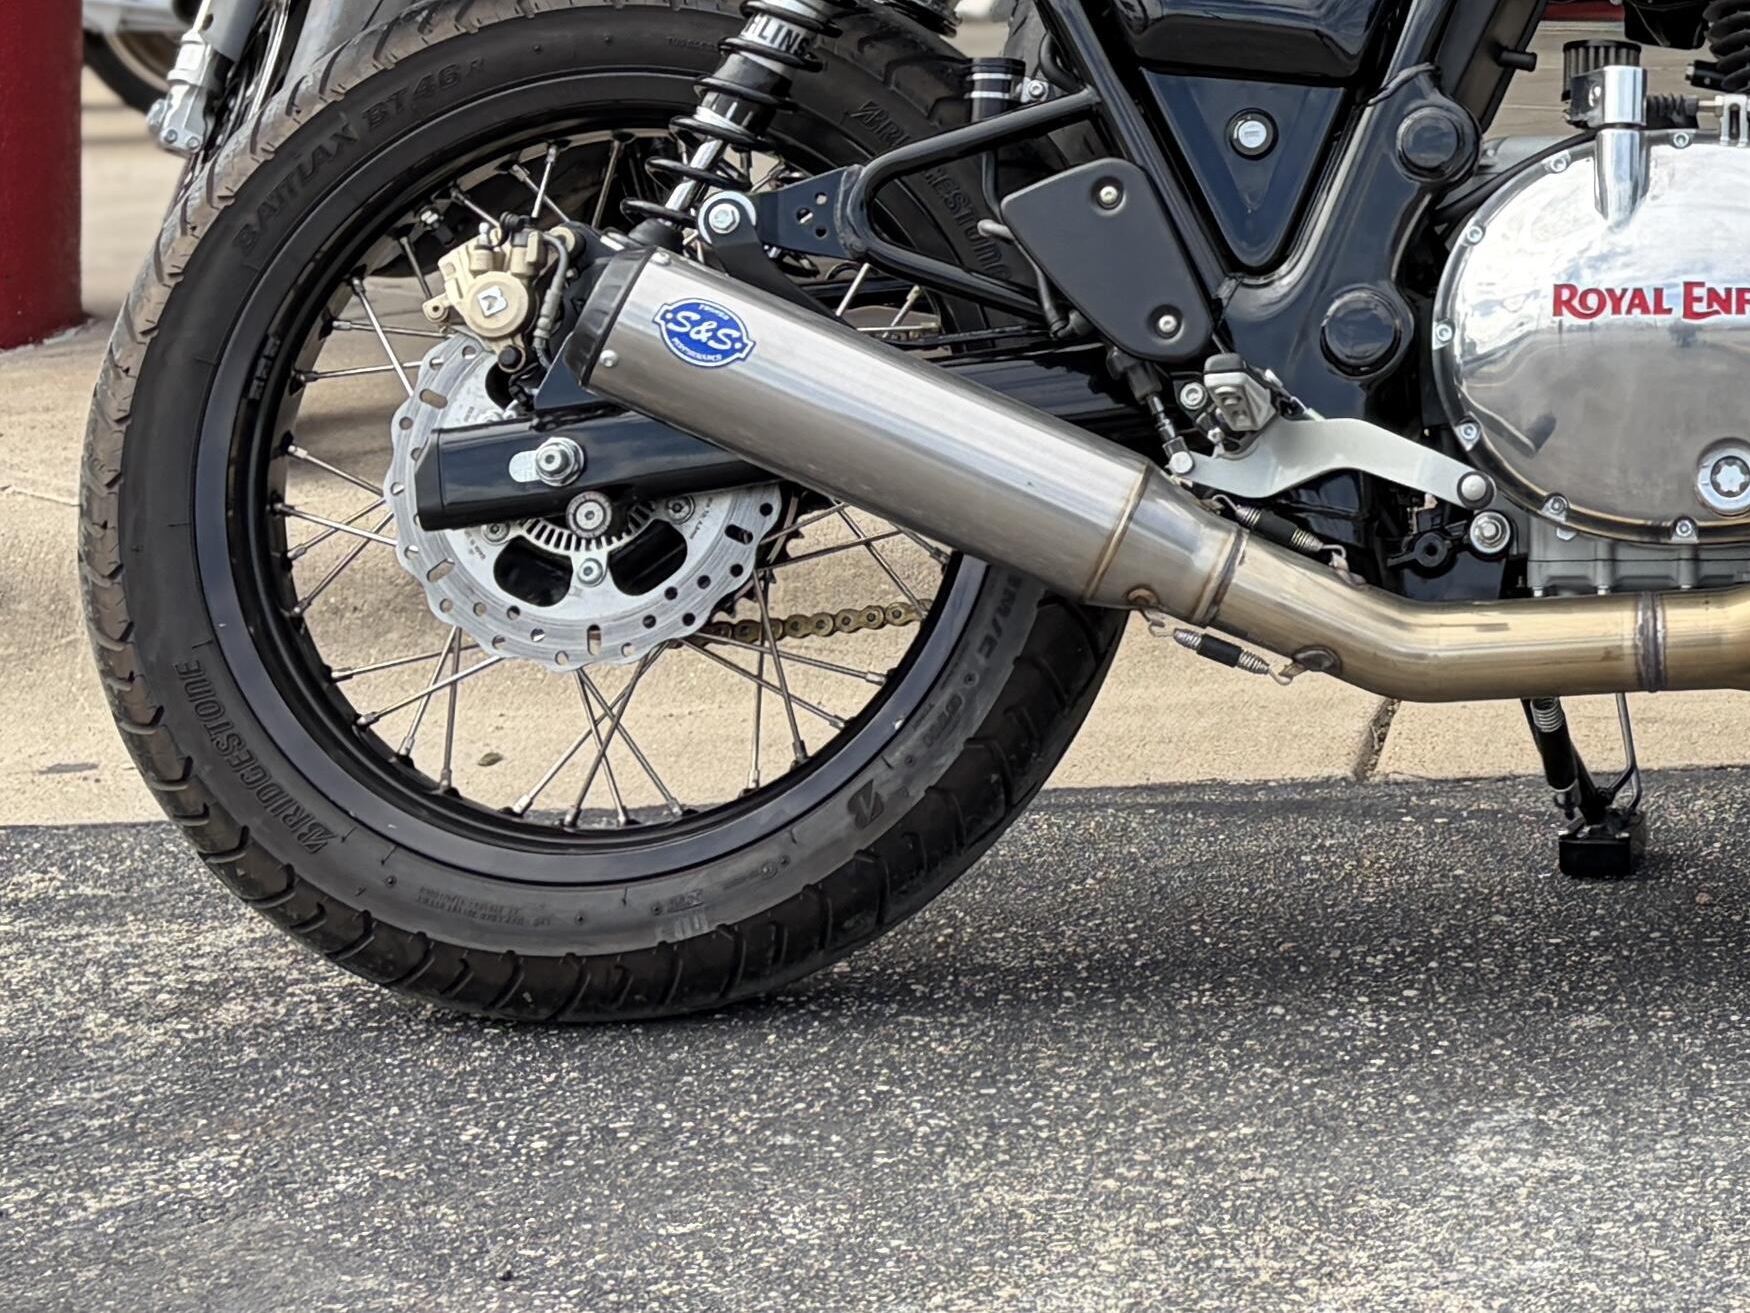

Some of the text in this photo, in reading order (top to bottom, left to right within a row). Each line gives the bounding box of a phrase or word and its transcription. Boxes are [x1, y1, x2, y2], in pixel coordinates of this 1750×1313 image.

[1552, 283, 1674, 320] ROYAL
[666, 310, 742, 350] S&S
[173, 658, 338, 855] BRIDGESTONE
